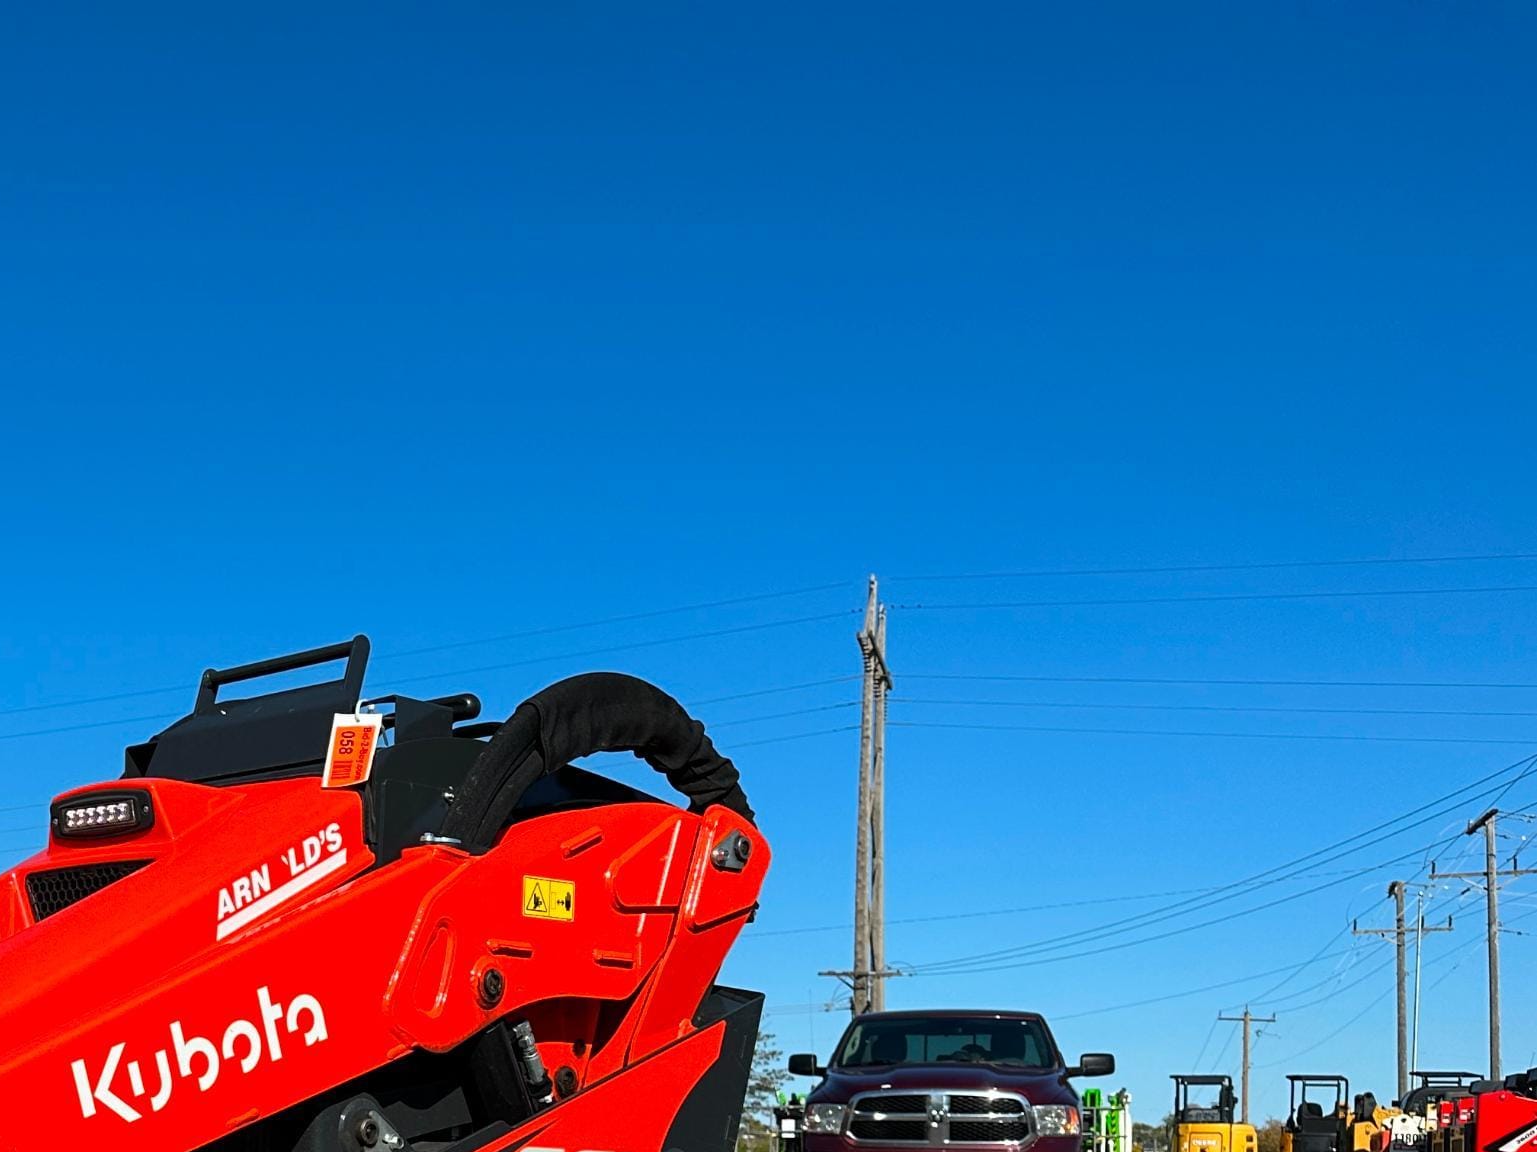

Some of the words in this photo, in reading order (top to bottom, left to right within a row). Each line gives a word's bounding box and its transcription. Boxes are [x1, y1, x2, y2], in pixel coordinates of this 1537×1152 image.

[338, 730, 356, 755] 058
[217, 822, 343, 921] ARNLD'S
[70, 985, 329, 1123] Kubota
